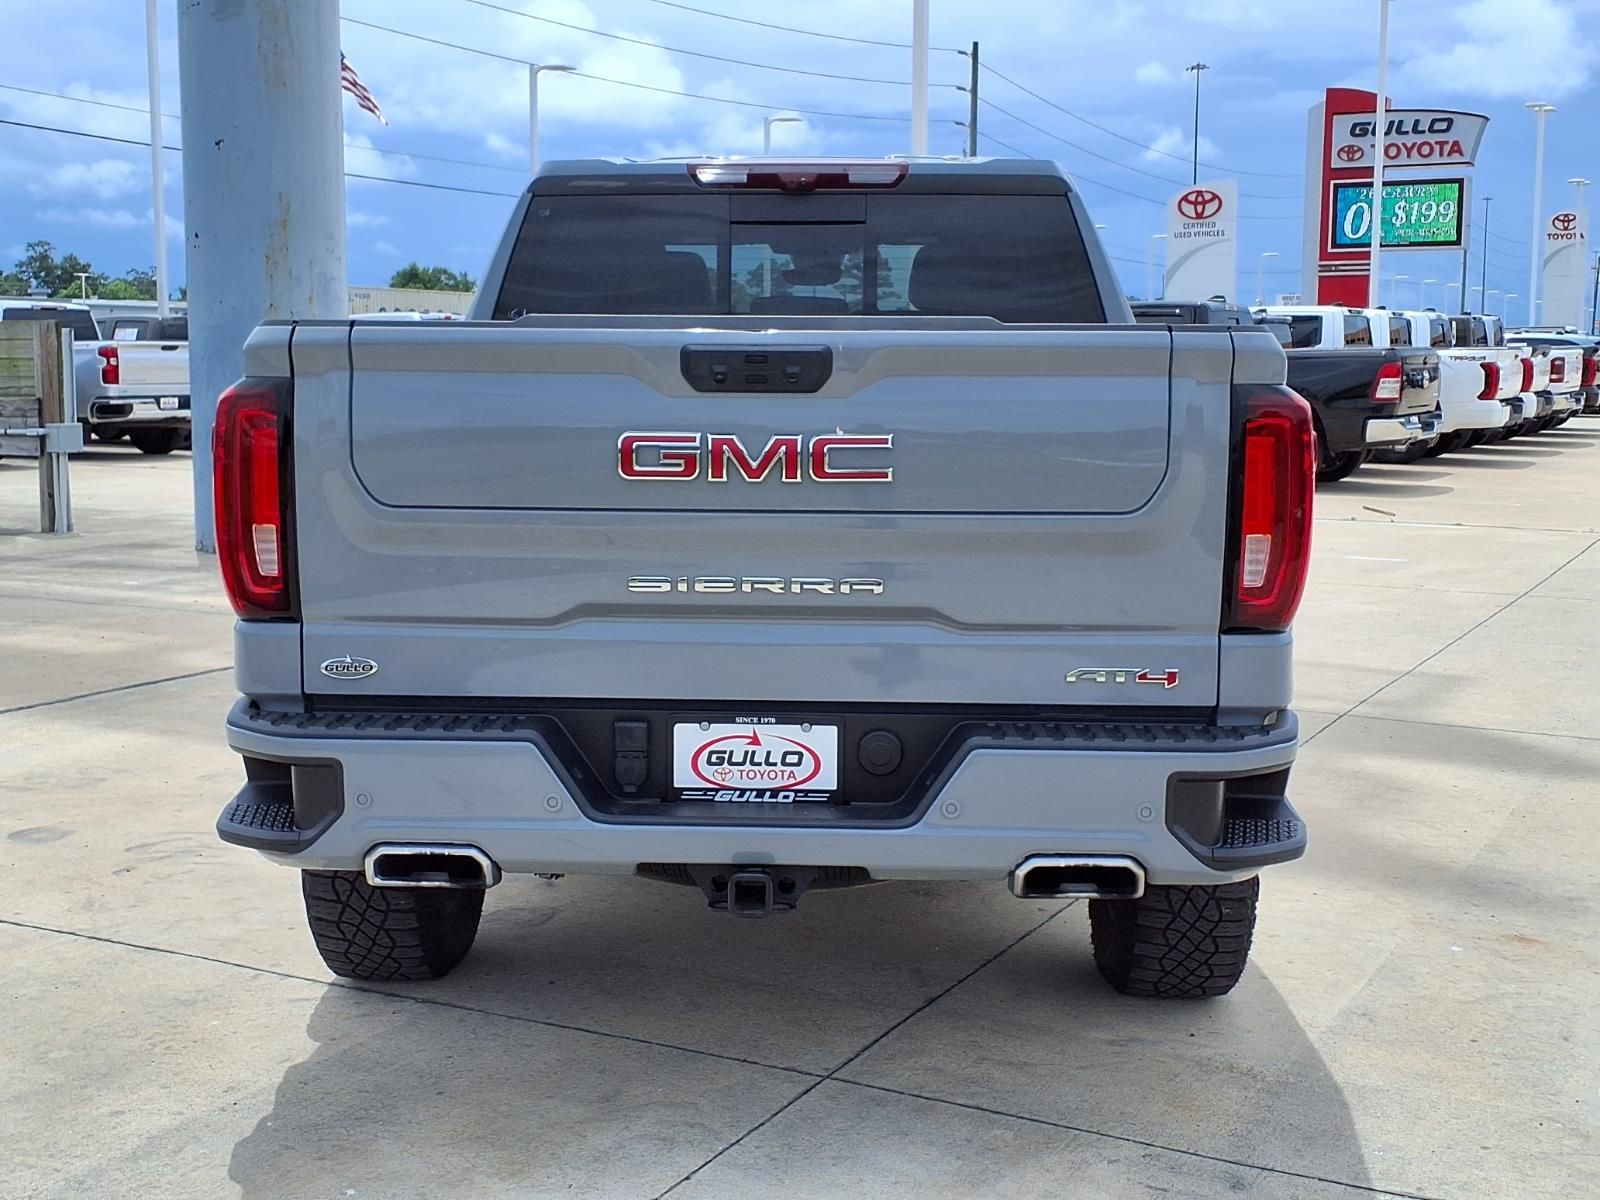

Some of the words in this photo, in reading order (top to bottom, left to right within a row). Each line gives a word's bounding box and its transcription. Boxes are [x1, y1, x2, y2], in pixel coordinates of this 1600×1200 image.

[1349, 117, 1454, 138] GULLO
[1391, 198, 1456, 228] $199
[1183, 221, 1216, 230] CERTIFIED
[1174, 231, 1192, 239] USED
[1193, 229, 1225, 238] VEHICLES
[617, 430, 894, 483] GMC
[626, 575, 885, 595] SIERRA
[324, 663, 374, 673] GULLO
[1066, 667, 1180, 689] AT4
[735, 716, 759, 724] SINCE
[760, 716, 776, 724] 1970
[705, 749, 804, 768] GULLO
[737, 769, 798, 781] TOYOTA
[713, 789, 796, 803] GULLO
